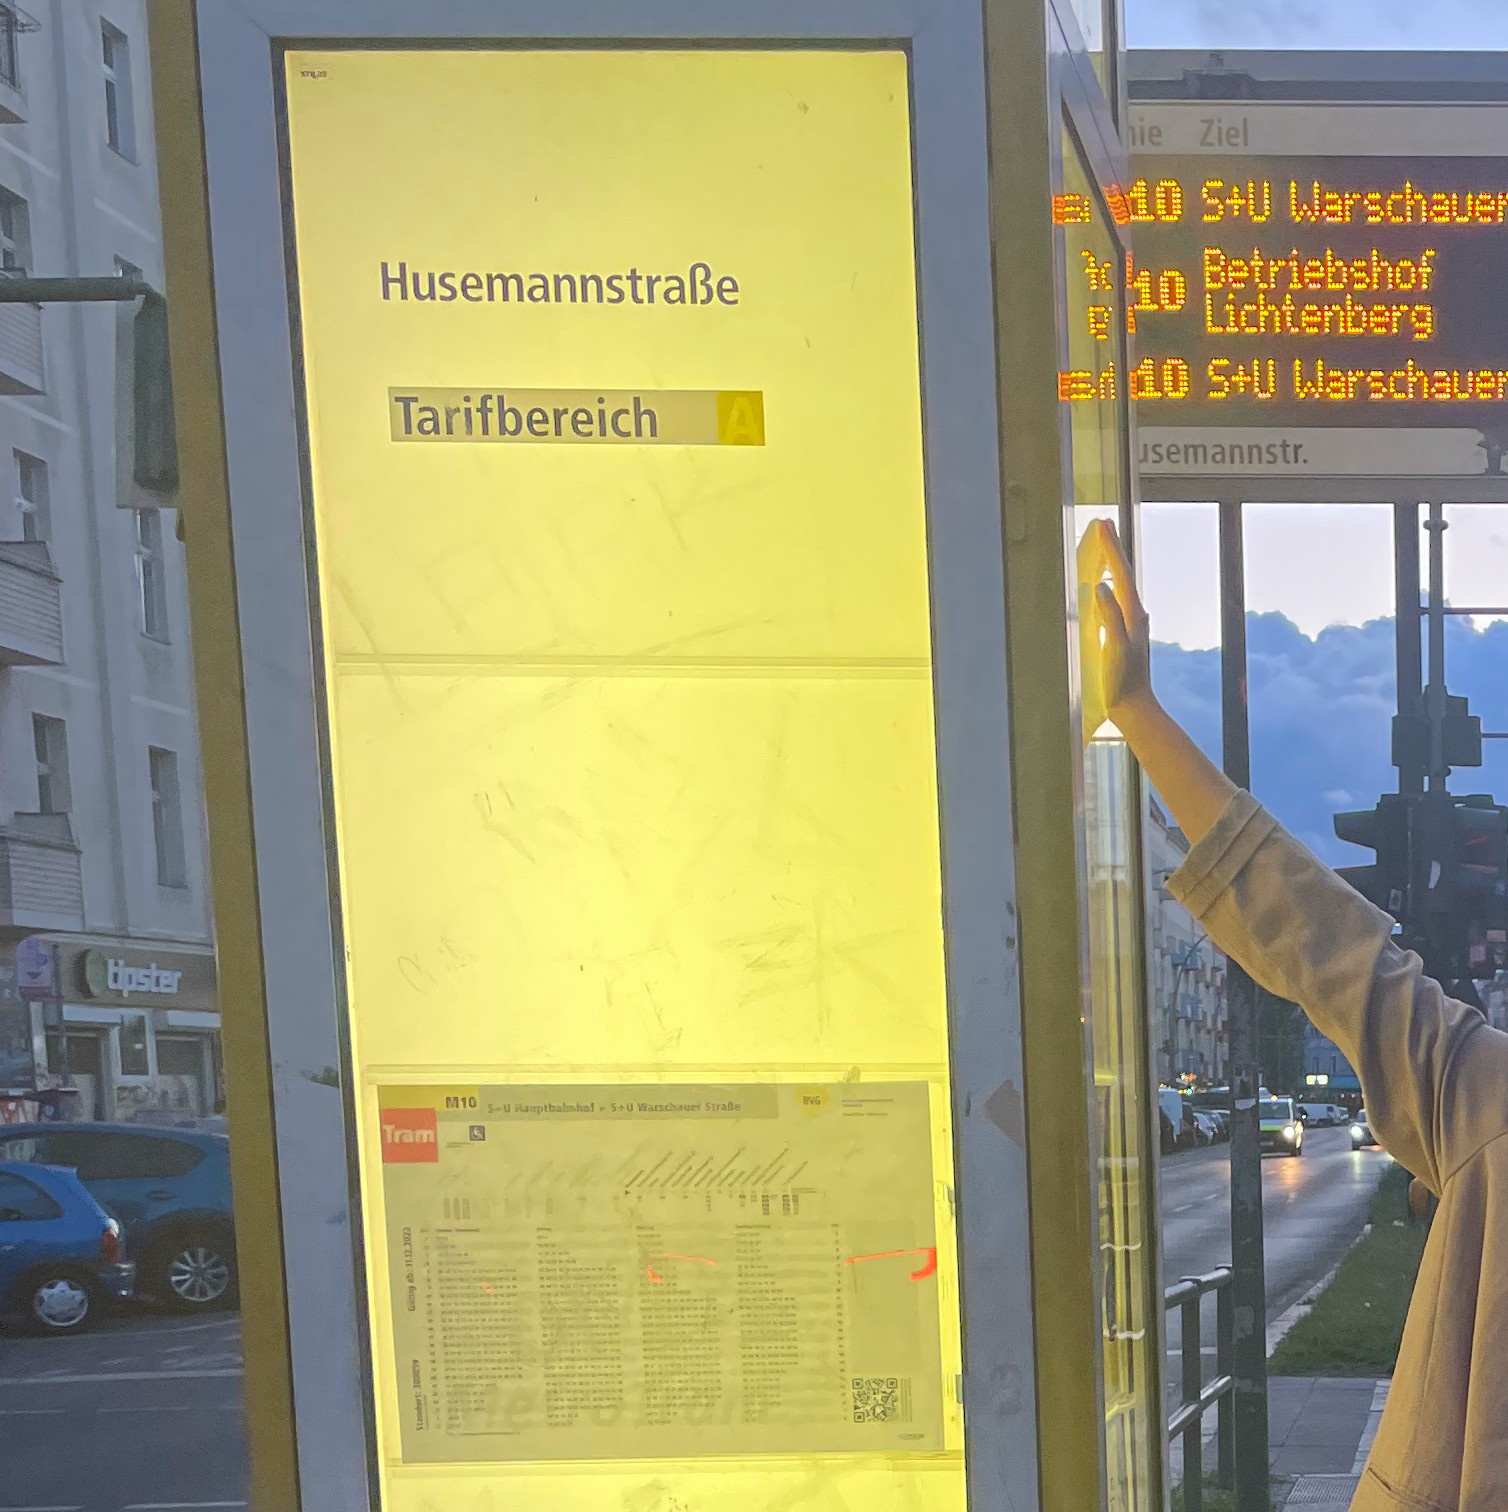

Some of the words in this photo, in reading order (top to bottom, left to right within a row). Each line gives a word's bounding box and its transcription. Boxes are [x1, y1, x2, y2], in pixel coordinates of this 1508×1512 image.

[1128, 117, 1163, 147] nie
[1199, 117, 1250, 148] Ziel
[1129, 179, 1184, 223] 10
[1201, 179, 1271, 223] S+U
[380, 261, 741, 306] Husemannstraße
[1203, 246, 1437, 289] Betriebshof
[1132, 269, 1186, 313] 10
[1205, 292, 1434, 341] Lichtenberg
[1134, 356, 1189, 400] 10
[1207, 357, 1276, 400] S+U
[394, 393, 658, 439] Tarifbereich
[723, 394, 761, 445] A
[1138, 438, 1309, 465] usemannstr.
[107, 958, 183, 998] tipster
[445, 1096, 477, 1109] M10
[638, 1101, 701, 1113] Warschauer
[382, 1124, 435, 1144] Tram
